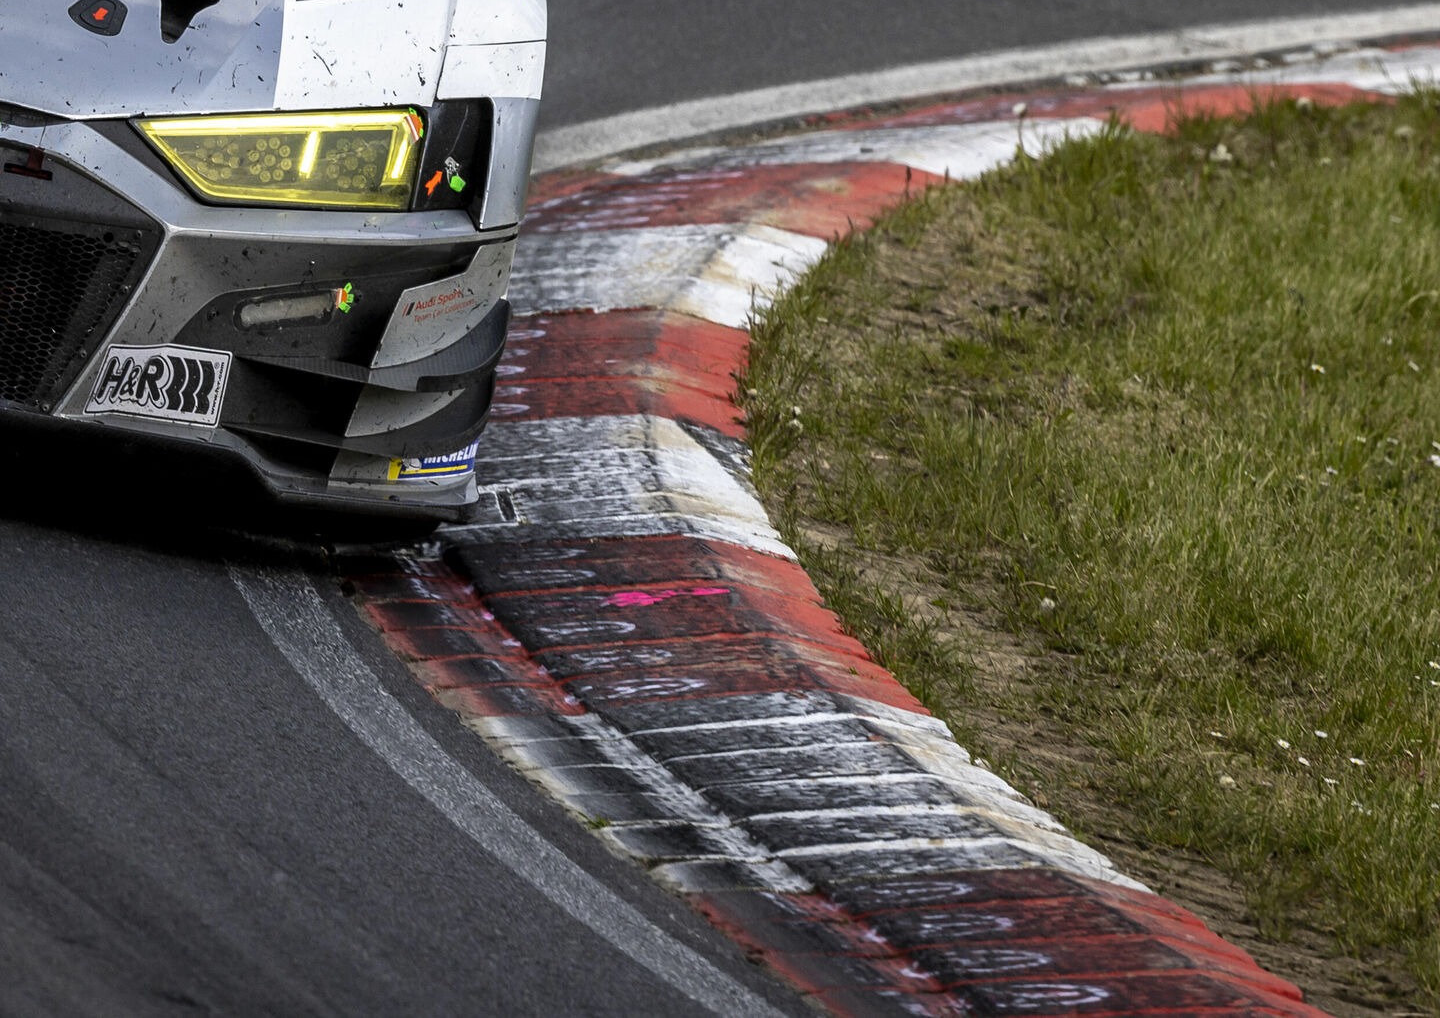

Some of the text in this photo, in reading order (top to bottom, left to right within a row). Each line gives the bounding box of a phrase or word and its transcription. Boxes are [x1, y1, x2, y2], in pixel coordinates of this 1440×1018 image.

[414, 288, 463, 311] Audi Sport
[96, 356, 171, 408] H&R
